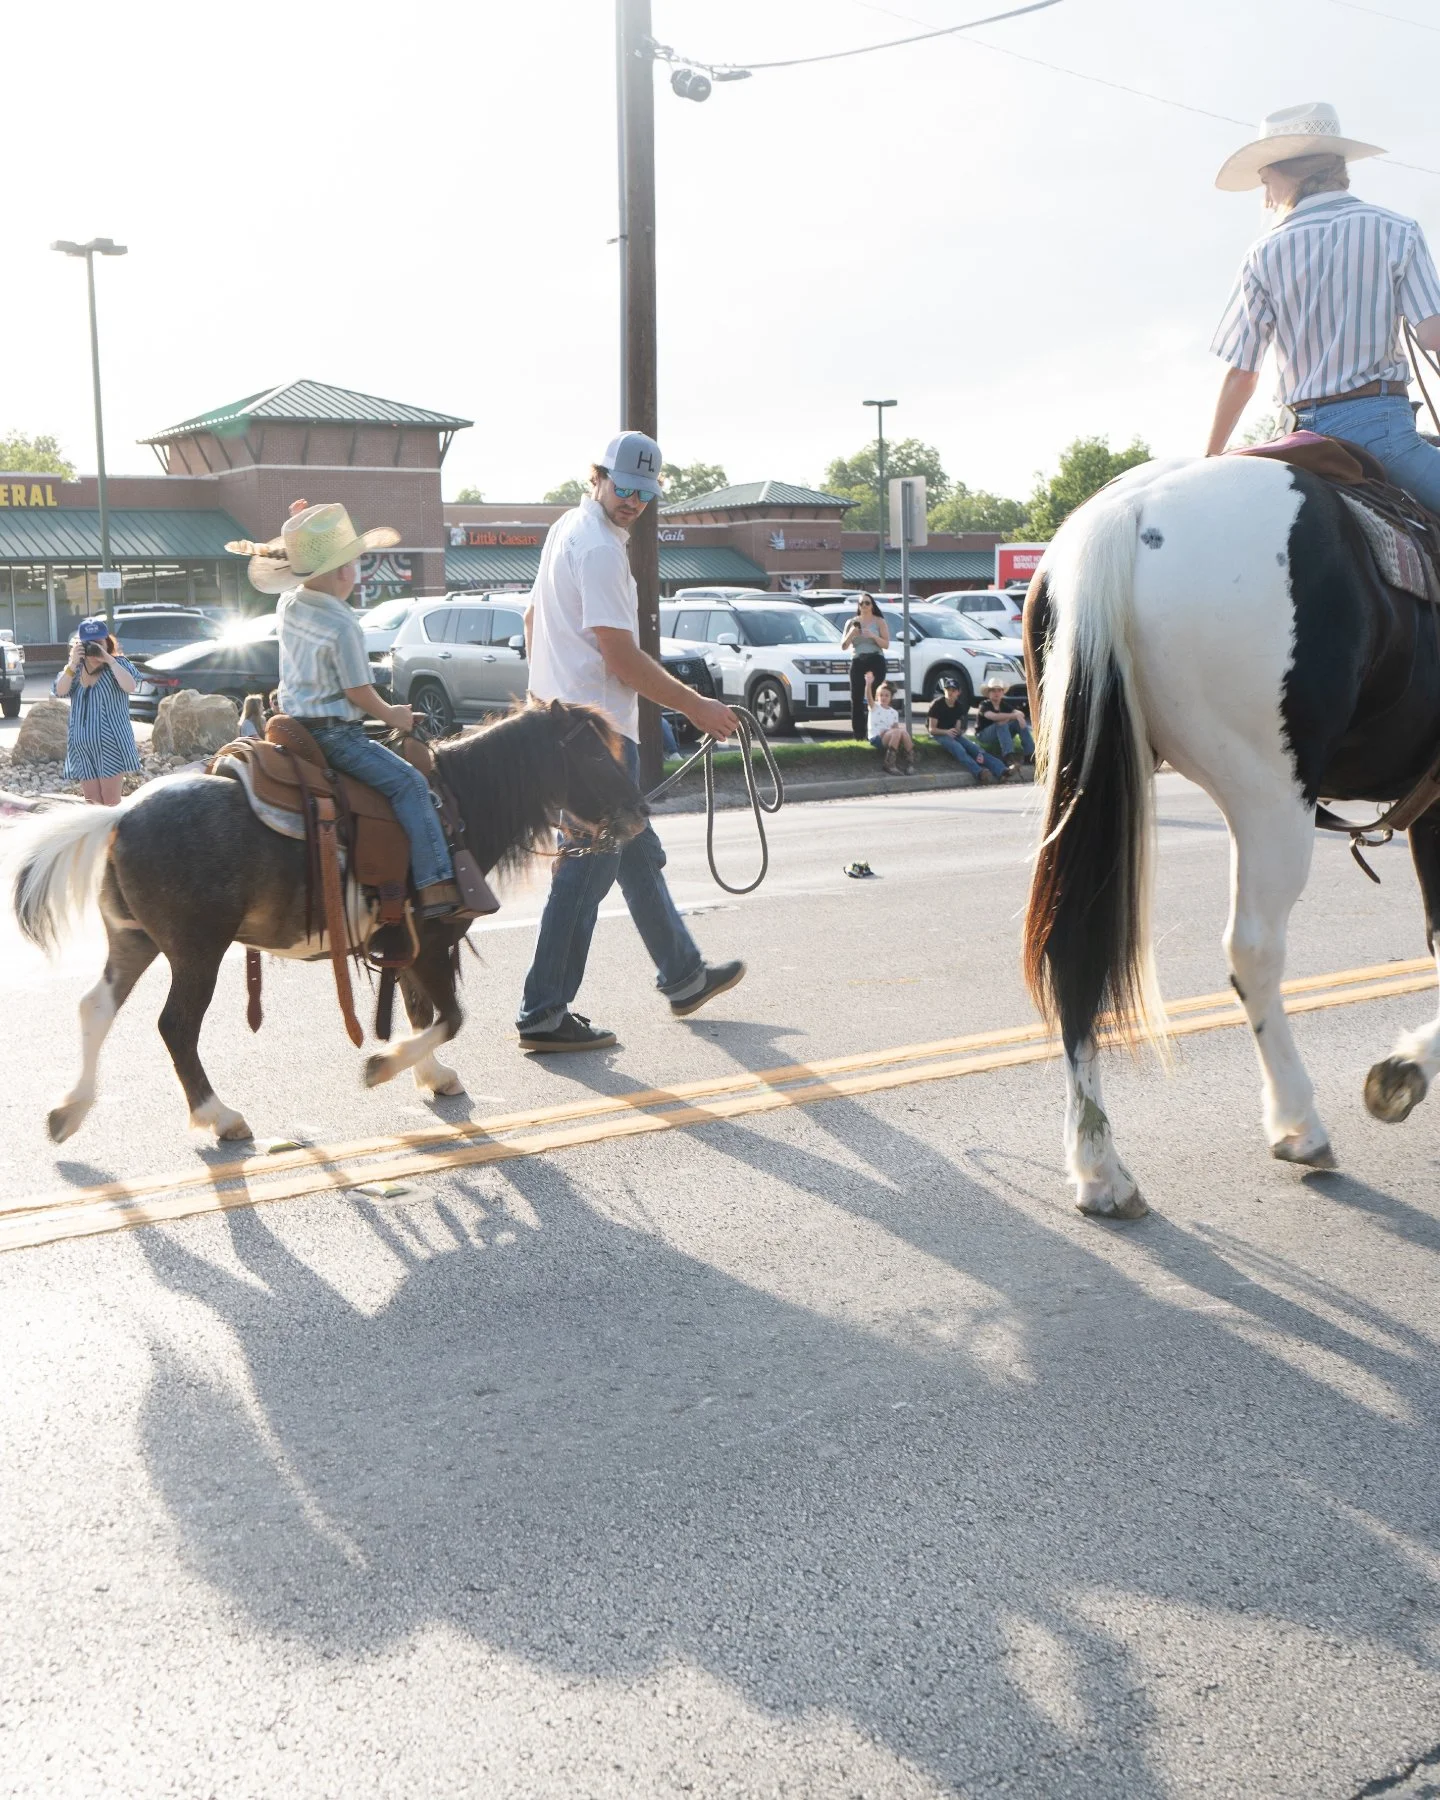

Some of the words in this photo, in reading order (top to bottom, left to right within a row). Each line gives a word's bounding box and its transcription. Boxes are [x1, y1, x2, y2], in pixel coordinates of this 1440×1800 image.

[0, 484, 58, 507] ERAL
[469, 531, 497, 545] Little
[500, 530, 537, 545] Caesars
[657, 529, 685, 542] Nails
